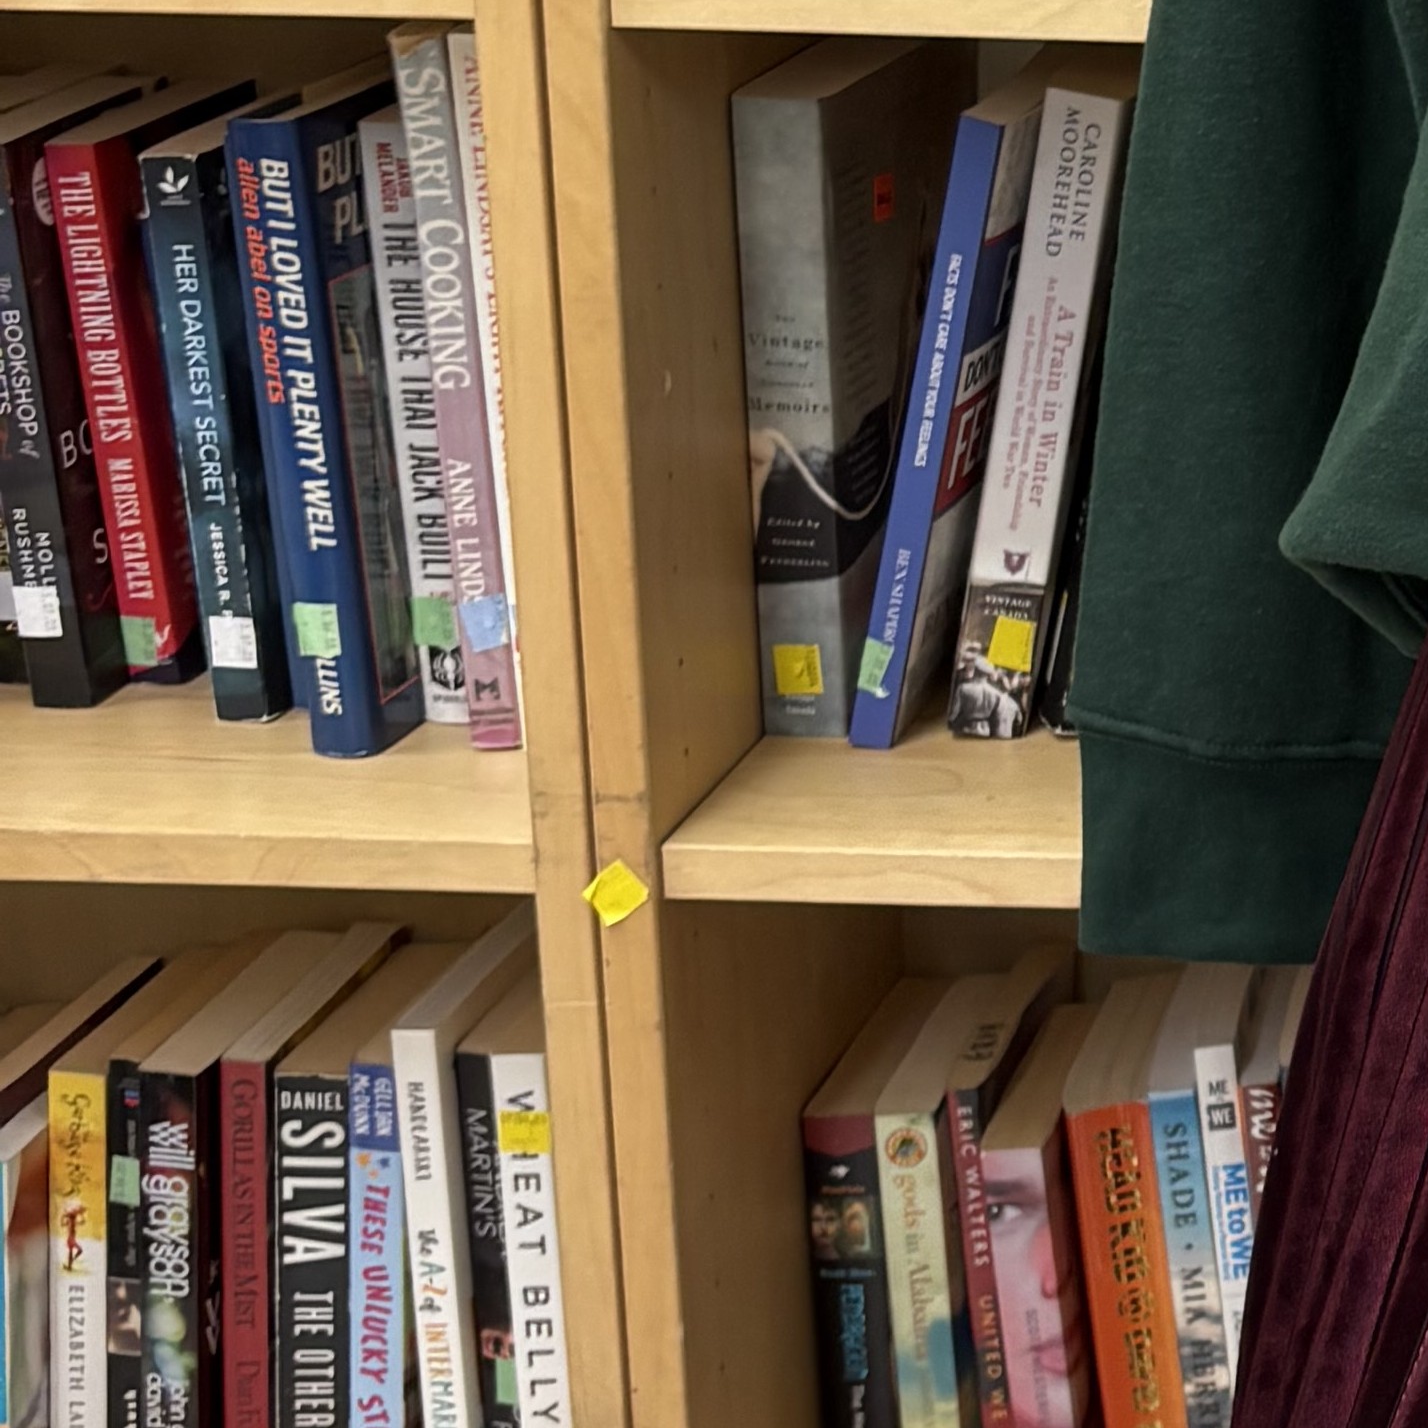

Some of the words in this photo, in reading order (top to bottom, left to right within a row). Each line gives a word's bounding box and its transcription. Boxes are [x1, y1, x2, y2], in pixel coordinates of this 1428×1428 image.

[404, 69, 455, 206] SMART
[1044, 107, 1081, 257] MOOREHEAD
[1067, 123, 1101, 241] CAROLINE
[257, 158, 292, 218] BUT
[171, 244, 197, 293] HER
[269, 234, 307, 323] LOVED
[418, 219, 472, 392] COOKING
[177, 301, 212, 408] DARKEST
[282, 338, 313, 366] IT
[747, 334, 825, 350] Vintage
[291, 372, 326, 476] PLENTY
[748, 399, 830, 414] Memoirs
[197, 416, 228, 506] SECRET
[445, 458, 478, 541] ANNE
[304, 480, 338, 551] WELL
[281, 1091, 344, 1110] DANIEL
[957, 1106, 973, 1157] ERIC
[281, 1121, 346, 1264] SILVA
[466, 1109, 497, 1238] MARTIN'S
[959, 1161, 990, 1266] WALTERS
[1163, 1123, 1198, 1228] SHADE
[68, 1285, 84, 1380] ELIZABETH
[294, 1290, 334, 1337] THE
[521, 1286, 560, 1426] BELLY
[293, 1347, 335, 1428] OTHER
